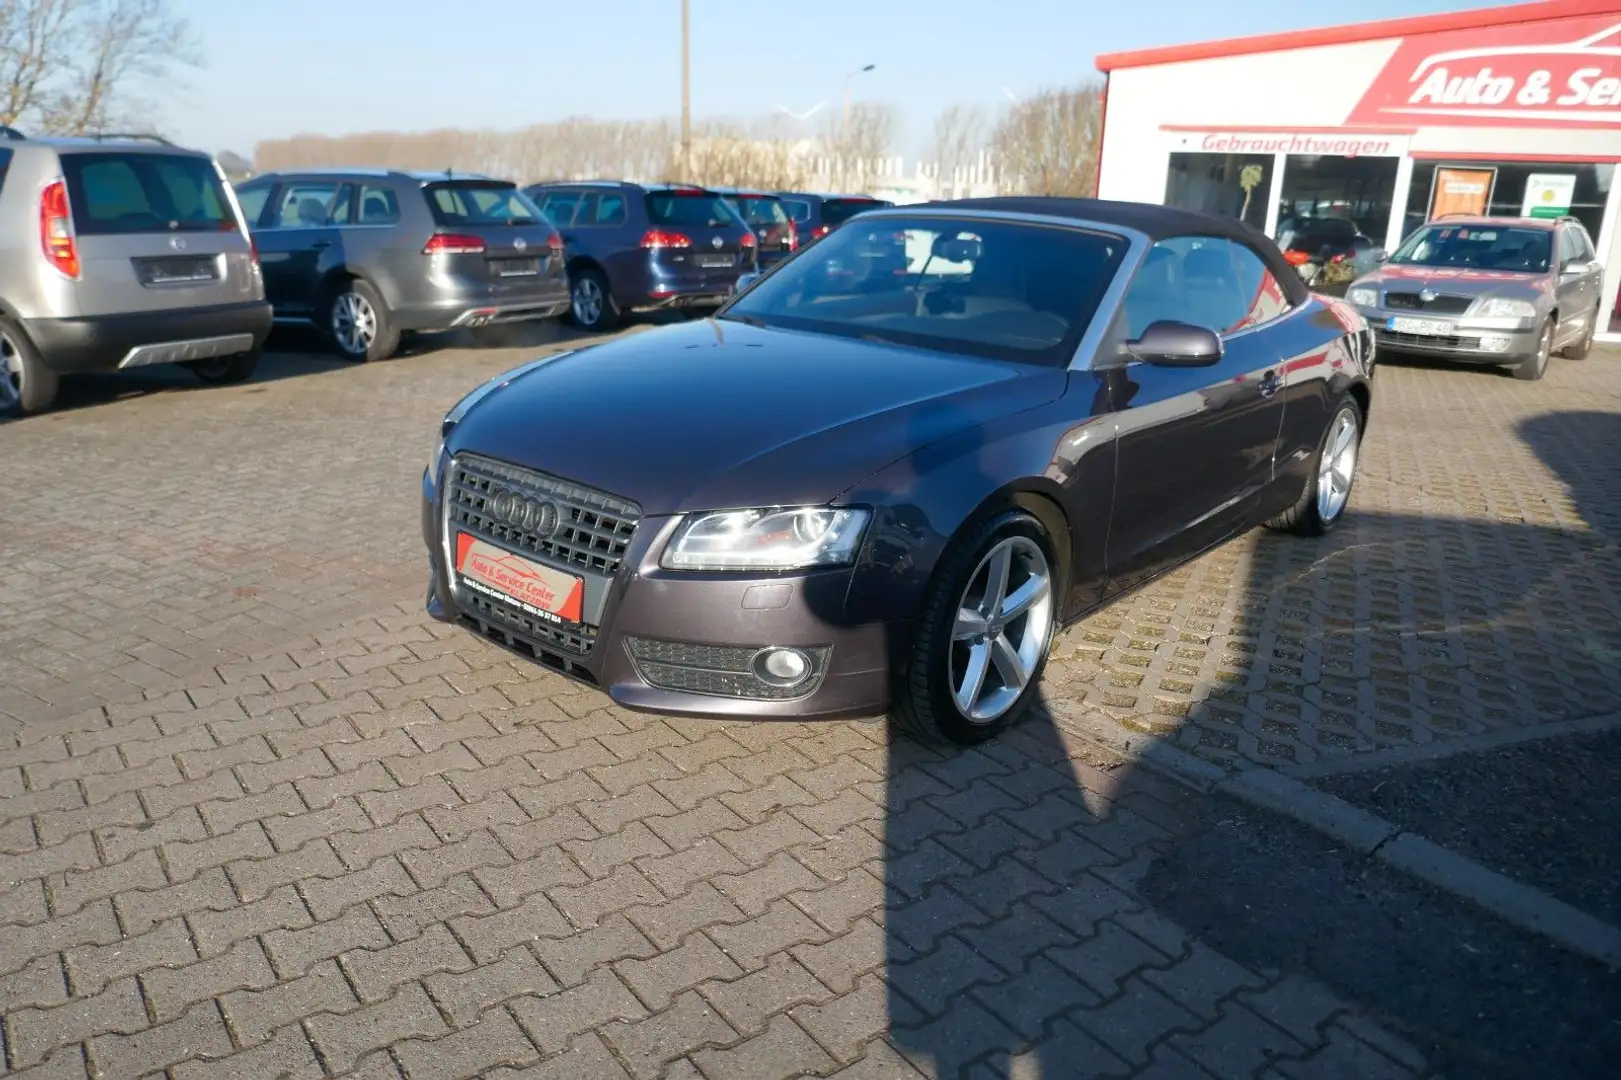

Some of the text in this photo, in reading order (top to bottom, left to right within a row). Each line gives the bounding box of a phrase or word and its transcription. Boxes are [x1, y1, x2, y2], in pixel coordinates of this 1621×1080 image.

[1408, 67, 1516, 104] Auto
[1516, 69, 1552, 105] &
[1202, 134, 1390, 158] Gebrauchtwagen
[471, 558, 490, 574] Auto
[495, 568, 526, 590] Service
[526, 582, 555, 601] Center
